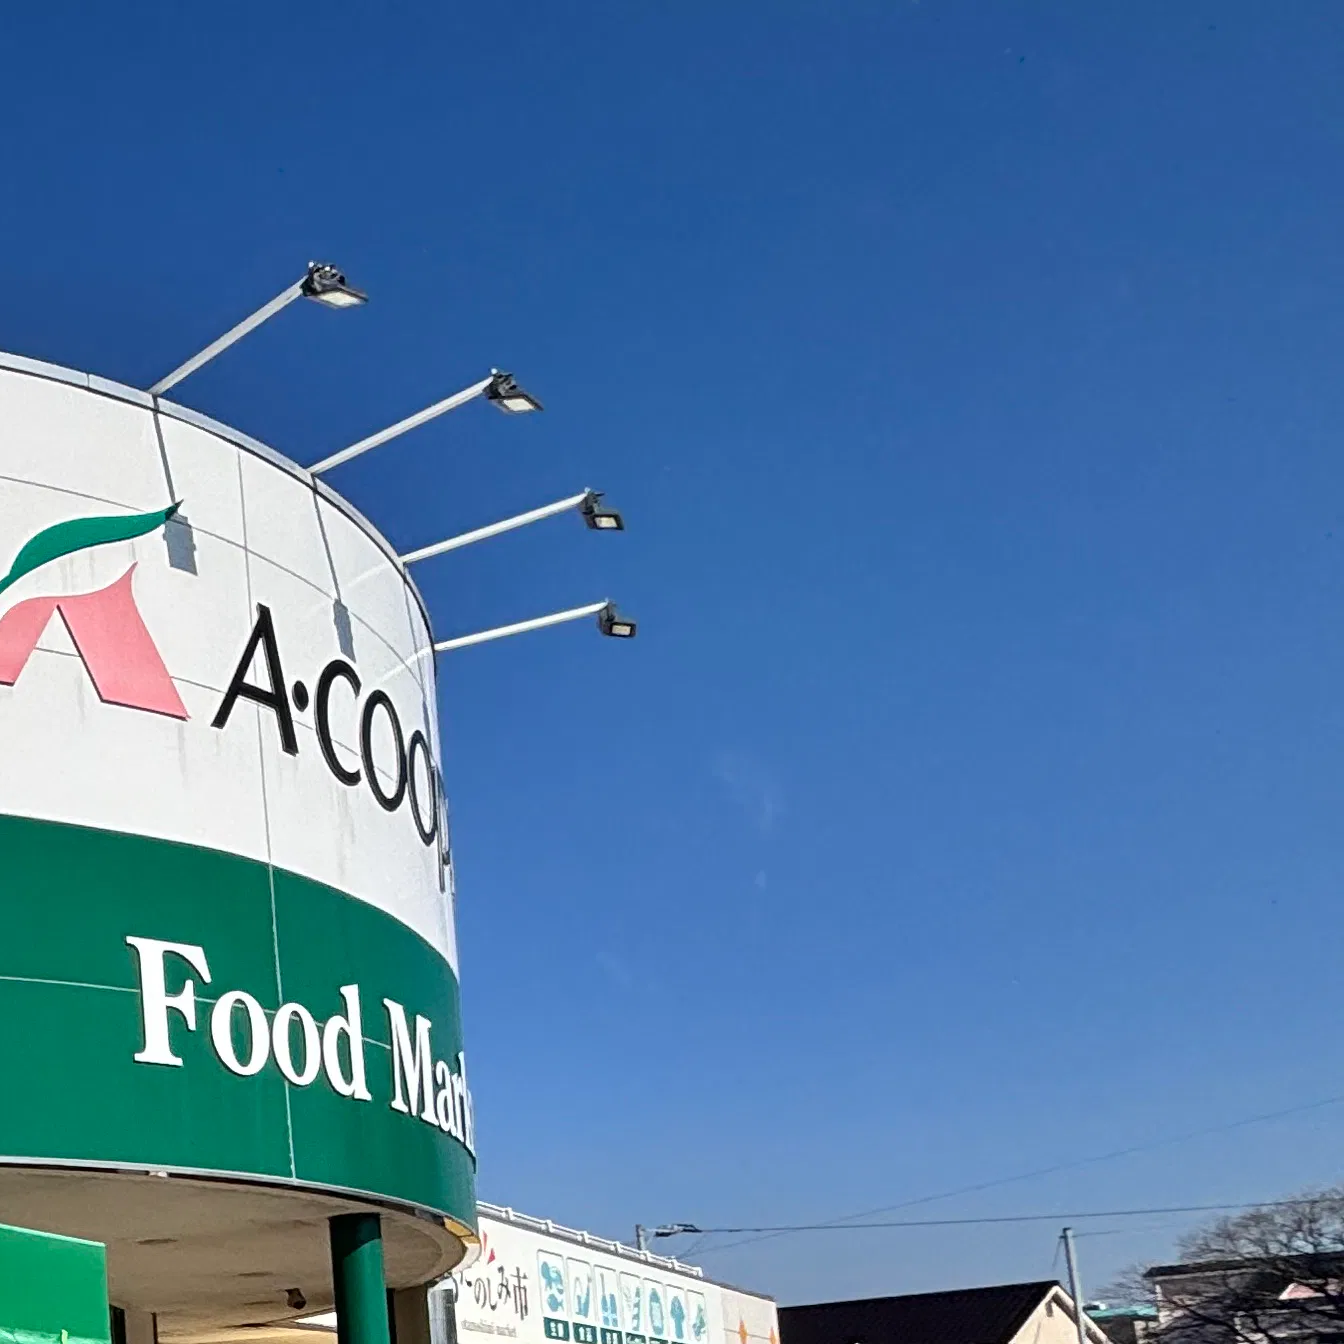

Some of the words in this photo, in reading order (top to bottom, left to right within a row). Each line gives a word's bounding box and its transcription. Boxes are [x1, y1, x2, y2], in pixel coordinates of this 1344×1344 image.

[126, 935, 372, 1101] Food
[452, 1266, 528, 1321] のしみ市
